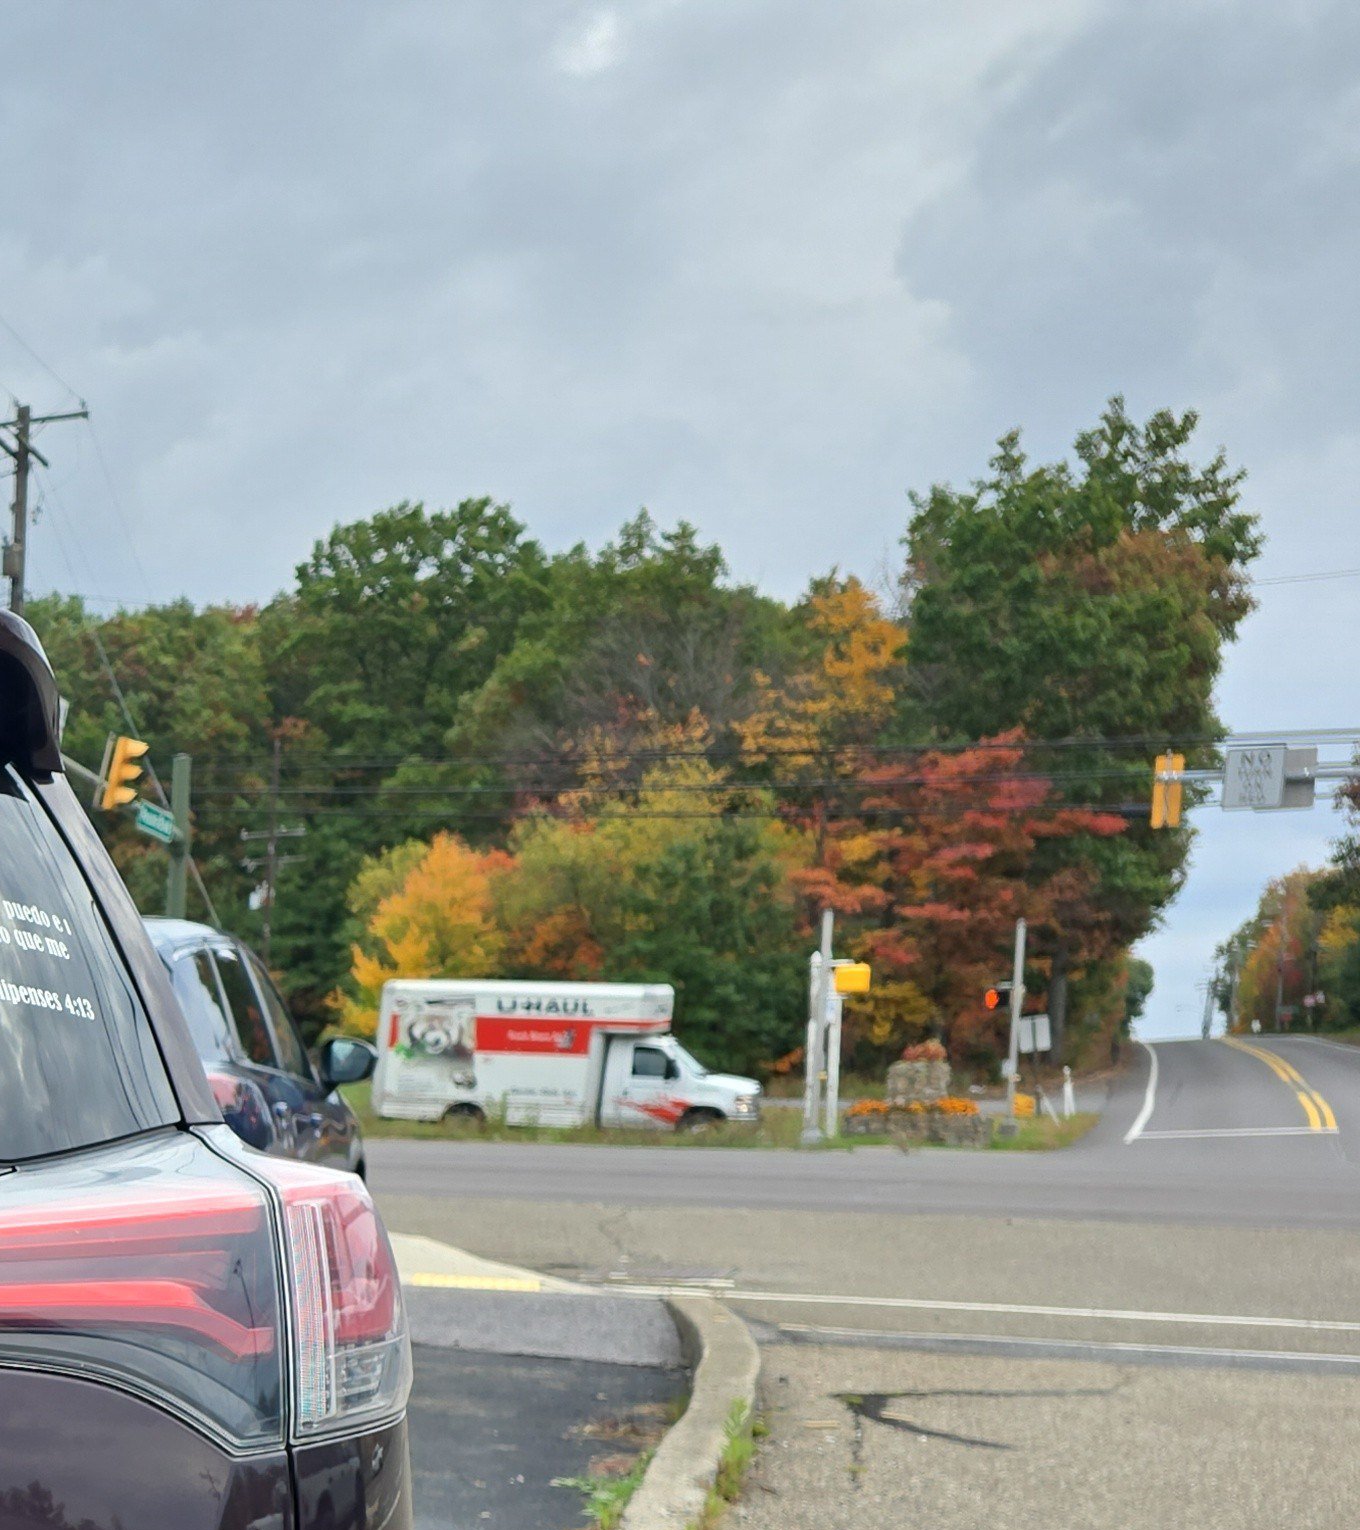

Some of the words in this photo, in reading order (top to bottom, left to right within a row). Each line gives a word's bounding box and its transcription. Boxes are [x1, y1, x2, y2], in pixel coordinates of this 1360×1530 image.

[2, 900, 51, 928] puedo
[13, 928, 45, 952] que
[45, 936, 70, 960] me
[64, 993, 95, 1021] 4:13
